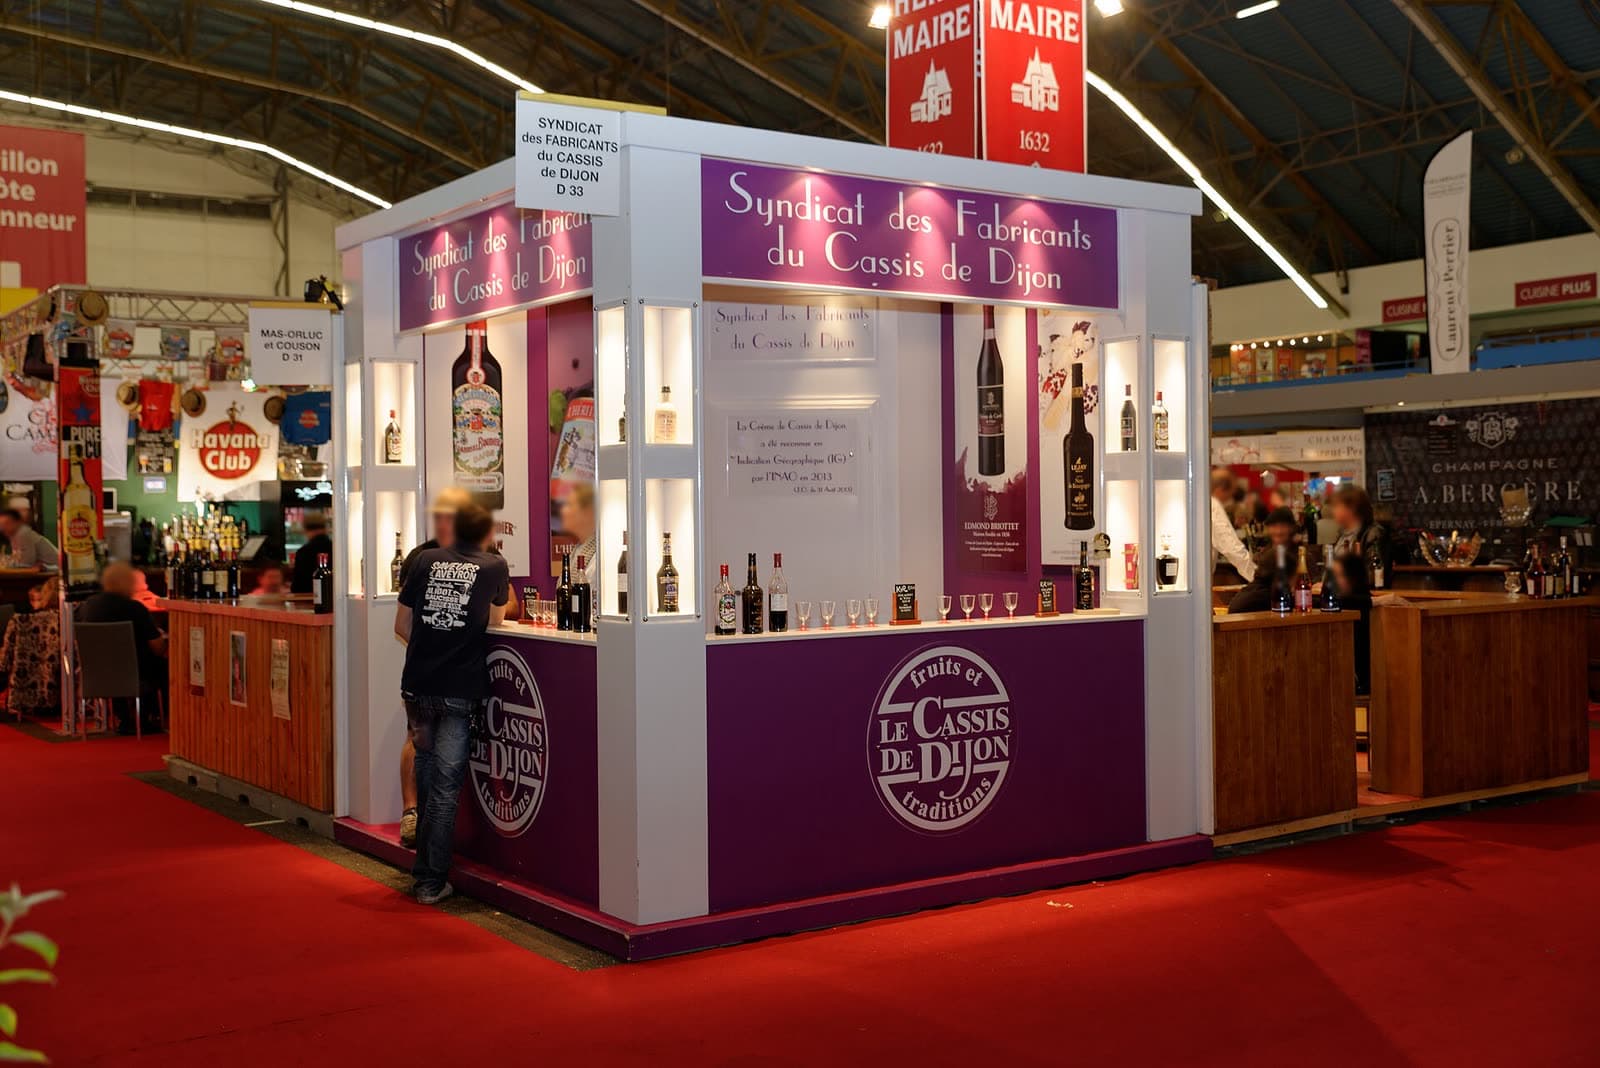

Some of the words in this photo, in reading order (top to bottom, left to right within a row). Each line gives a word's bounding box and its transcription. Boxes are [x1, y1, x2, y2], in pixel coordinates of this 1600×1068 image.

[893, 4, 971, 59] MAIRE
[990, 0, 1080, 43] MAIRE
[538, 117, 603, 135] SYNDICAT
[521, 132, 542, 145] des
[545, 134, 618, 153] FABRICANTS
[1019, 130, 1050, 152] 1632
[537, 150, 553, 162] du
[556, 152, 603, 167] CASSIS
[541, 166, 556, 179] de
[560, 168, 599, 182] DIJON
[556, 184, 566, 195] D
[569, 185, 584, 197] 33
[725, 170, 865, 227] Syndicat
[888, 191, 933, 234] des
[955, 198, 1092, 250] Fabricants
[413, 230, 474, 281] Syndicat
[483, 217, 508, 256] des
[767, 225, 804, 268] du
[824, 230, 924, 279] Cassis
[941, 243, 972, 282] de
[989, 246, 1061, 296] Dijon
[429, 276, 446, 311] du
[454, 267, 504, 306] Cassis
[511, 252, 529, 291] de
[538, 244, 586, 289] Dijon
[1442, 225, 1458, 353] Laurent-Perrier
[1519, 286, 1560, 301] CUISINE
[1561, 279, 1592, 296] PLUS
[1385, 303, 1421, 317] CUISINE
[260, 329, 324, 341] MAS-ORLUC
[263, 341, 275, 351] et
[276, 341, 321, 352] COUSON
[281, 353, 292, 362] D
[293, 353, 304, 362] 31
[70, 425, 101, 442] PURE
[191, 428, 272, 449] Havana
[205, 449, 251, 471] Club
[1432, 458, 1559, 474] CHAMPAGNE
[811, 472, 833, 482] 2013
[964, 522, 990, 531] EDMOND
[990, 522, 1019, 531] BRIOTTET
[431, 561, 480, 573] SAVEURS
[488, 660, 514, 685] ruits
[515, 677, 526, 696] et
[910, 657, 961, 689] fruits
[965, 667, 984, 687] et
[487, 696, 543, 747] CASSIS
[879, 719, 909, 744] LE
[912, 696, 1010, 739] CASSIS
[489, 739, 543, 802] DIJON
[880, 748, 914, 773] DE
[917, 735, 1010, 800] DIJON
[481, 781, 530, 821] traditions
[902, 777, 991, 820] traditions
